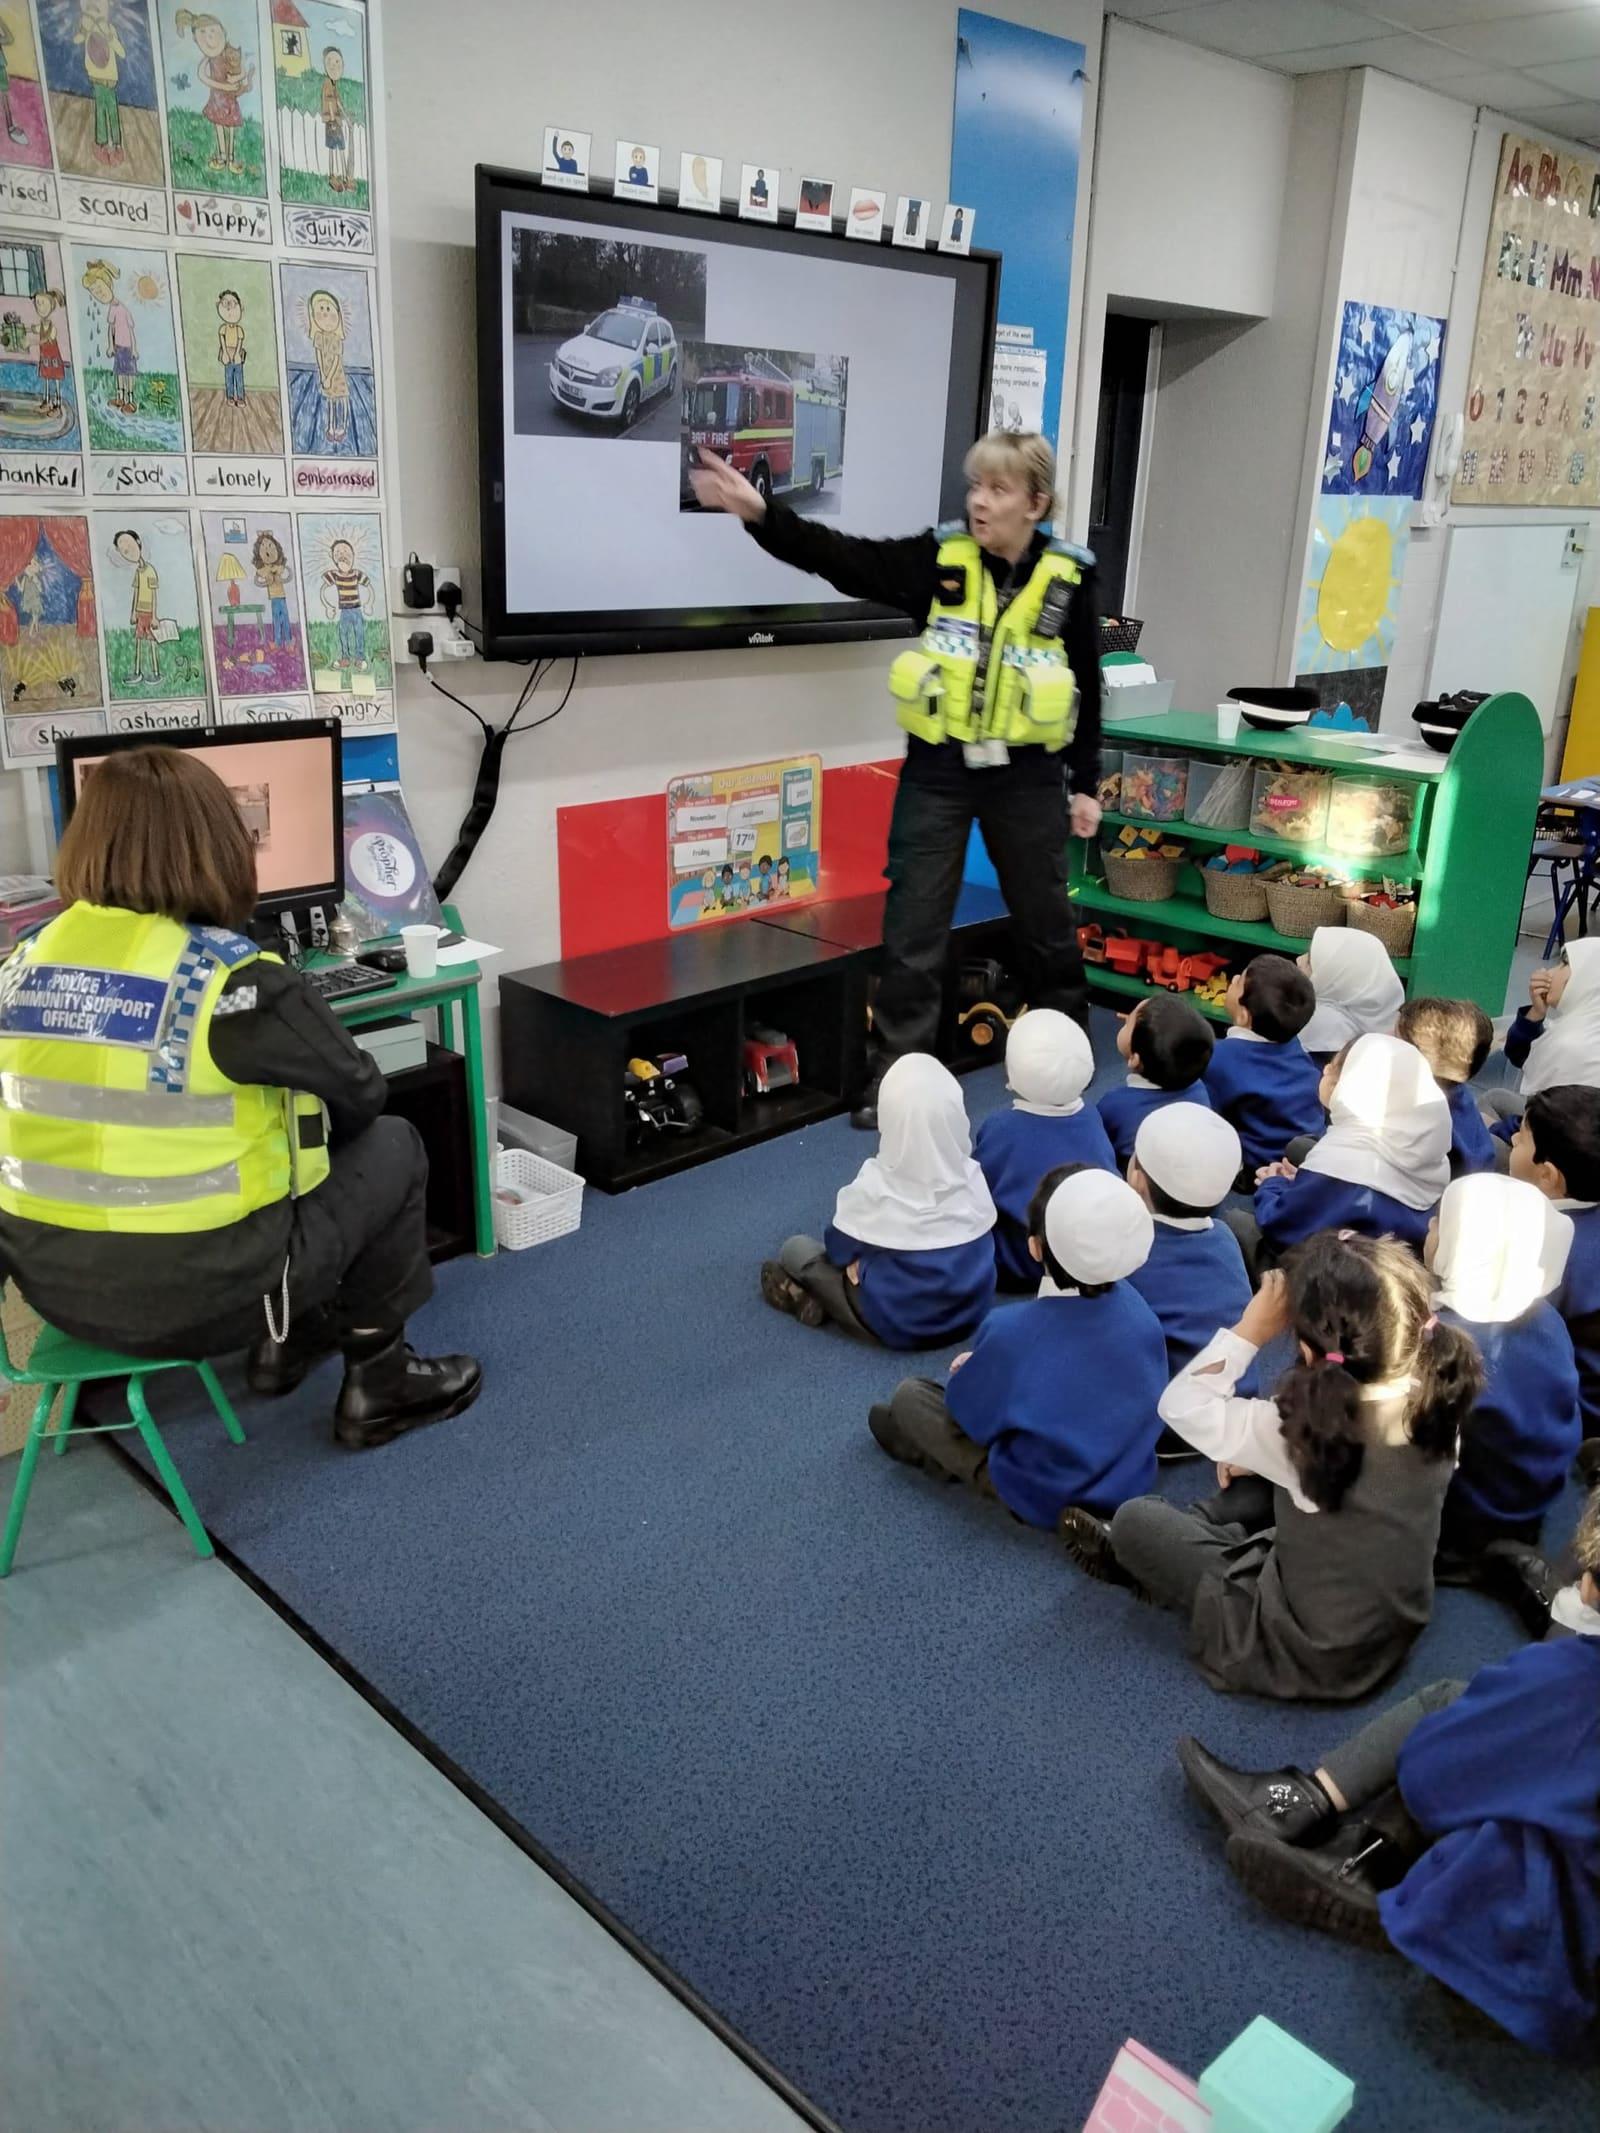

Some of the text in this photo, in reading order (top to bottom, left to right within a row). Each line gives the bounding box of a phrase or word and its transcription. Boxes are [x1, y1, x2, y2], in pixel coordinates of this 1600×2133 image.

[0, 180, 48, 203] rised
[80, 195, 148, 222] scared
[196, 202, 257, 236] happy
[306, 222, 356, 245] guilty
[1550, 249, 1583, 298] Mm
[0, 463, 77, 488] hankful
[218, 466, 271, 492] lonely
[298, 466, 375, 487] embarrassed
[119, 708, 201, 731] ashamed
[331, 702, 381, 721] angry
[736, 832, 755, 846] 17th
[52, 972, 101, 995] POLICE
[83, 994, 155, 1020] SUPPORT
[42, 1009, 96, 1032] OFFICER
